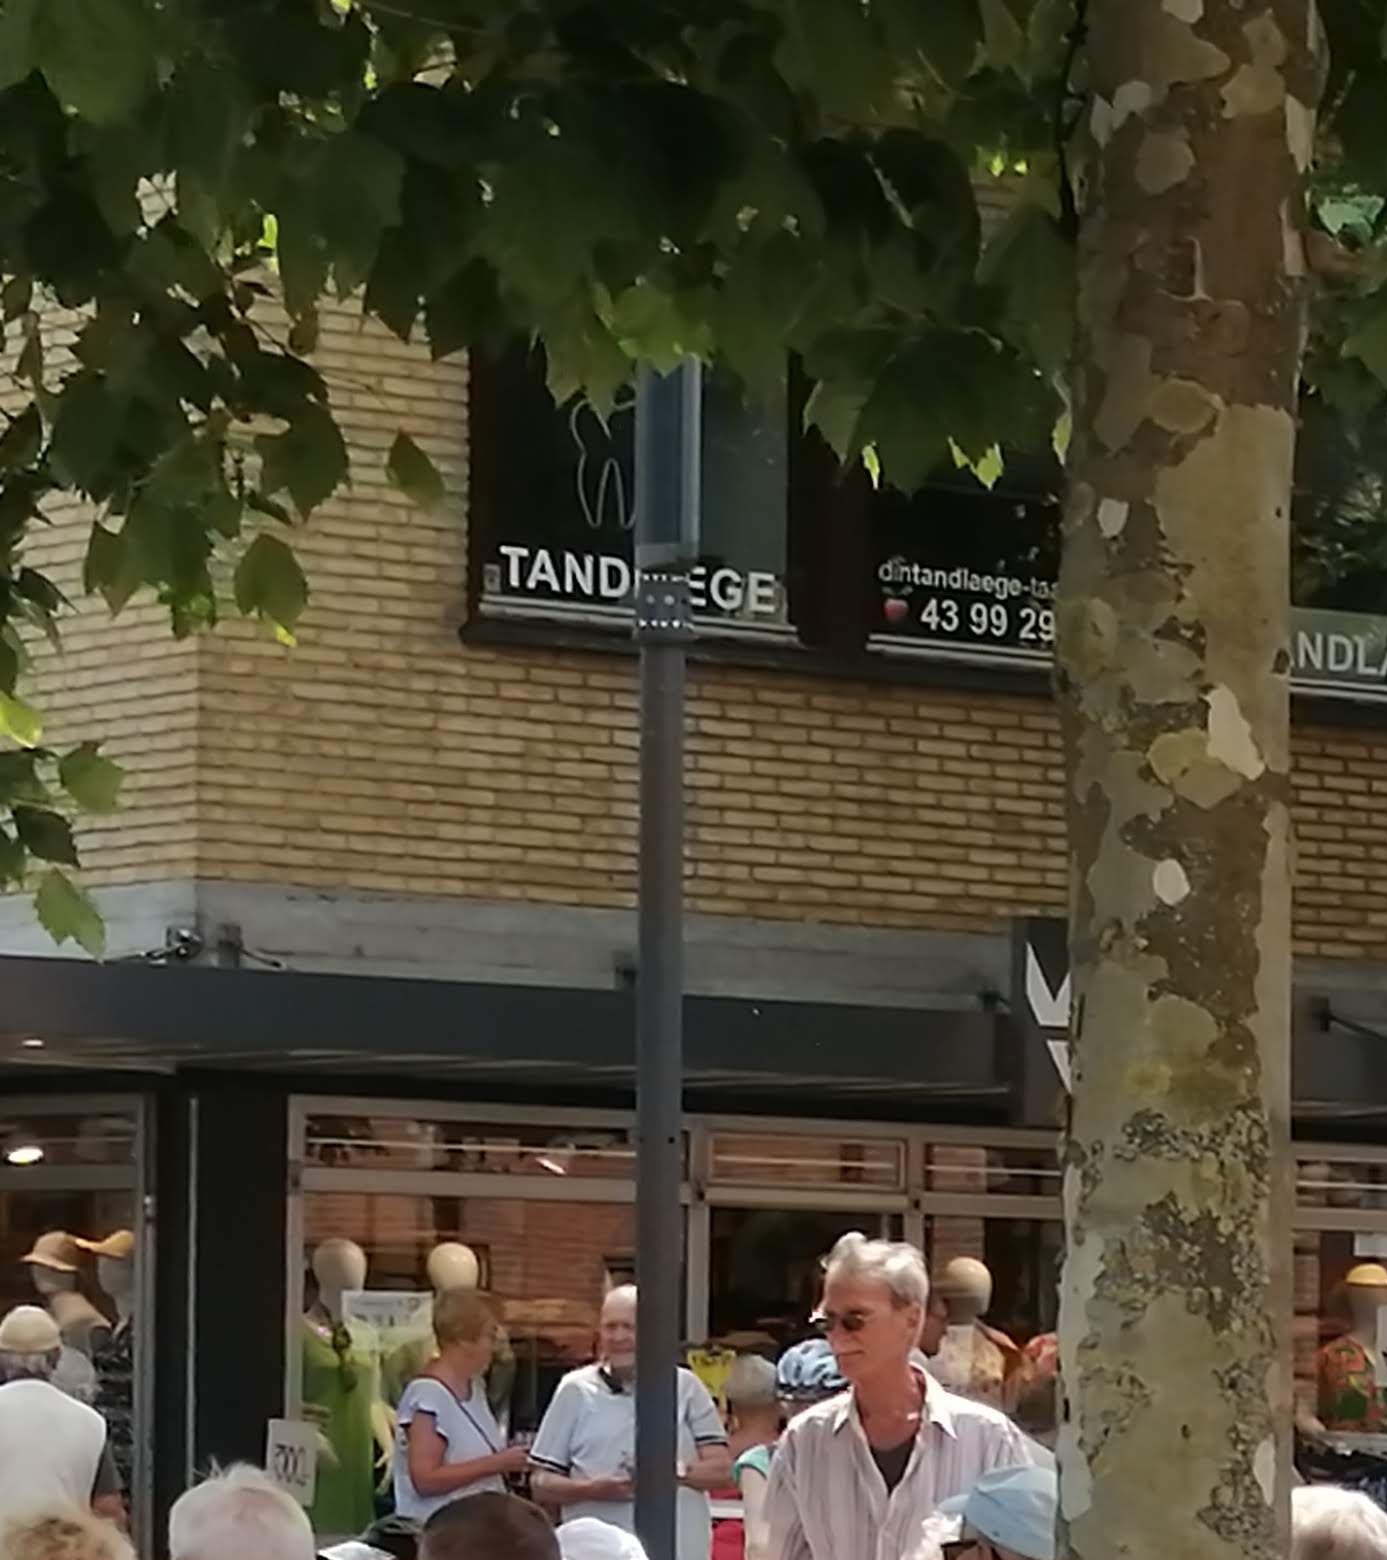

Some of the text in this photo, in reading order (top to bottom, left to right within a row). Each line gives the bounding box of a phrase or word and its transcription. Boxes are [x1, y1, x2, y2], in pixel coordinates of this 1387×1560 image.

[920, 598, 1056, 641] 43 99 29
